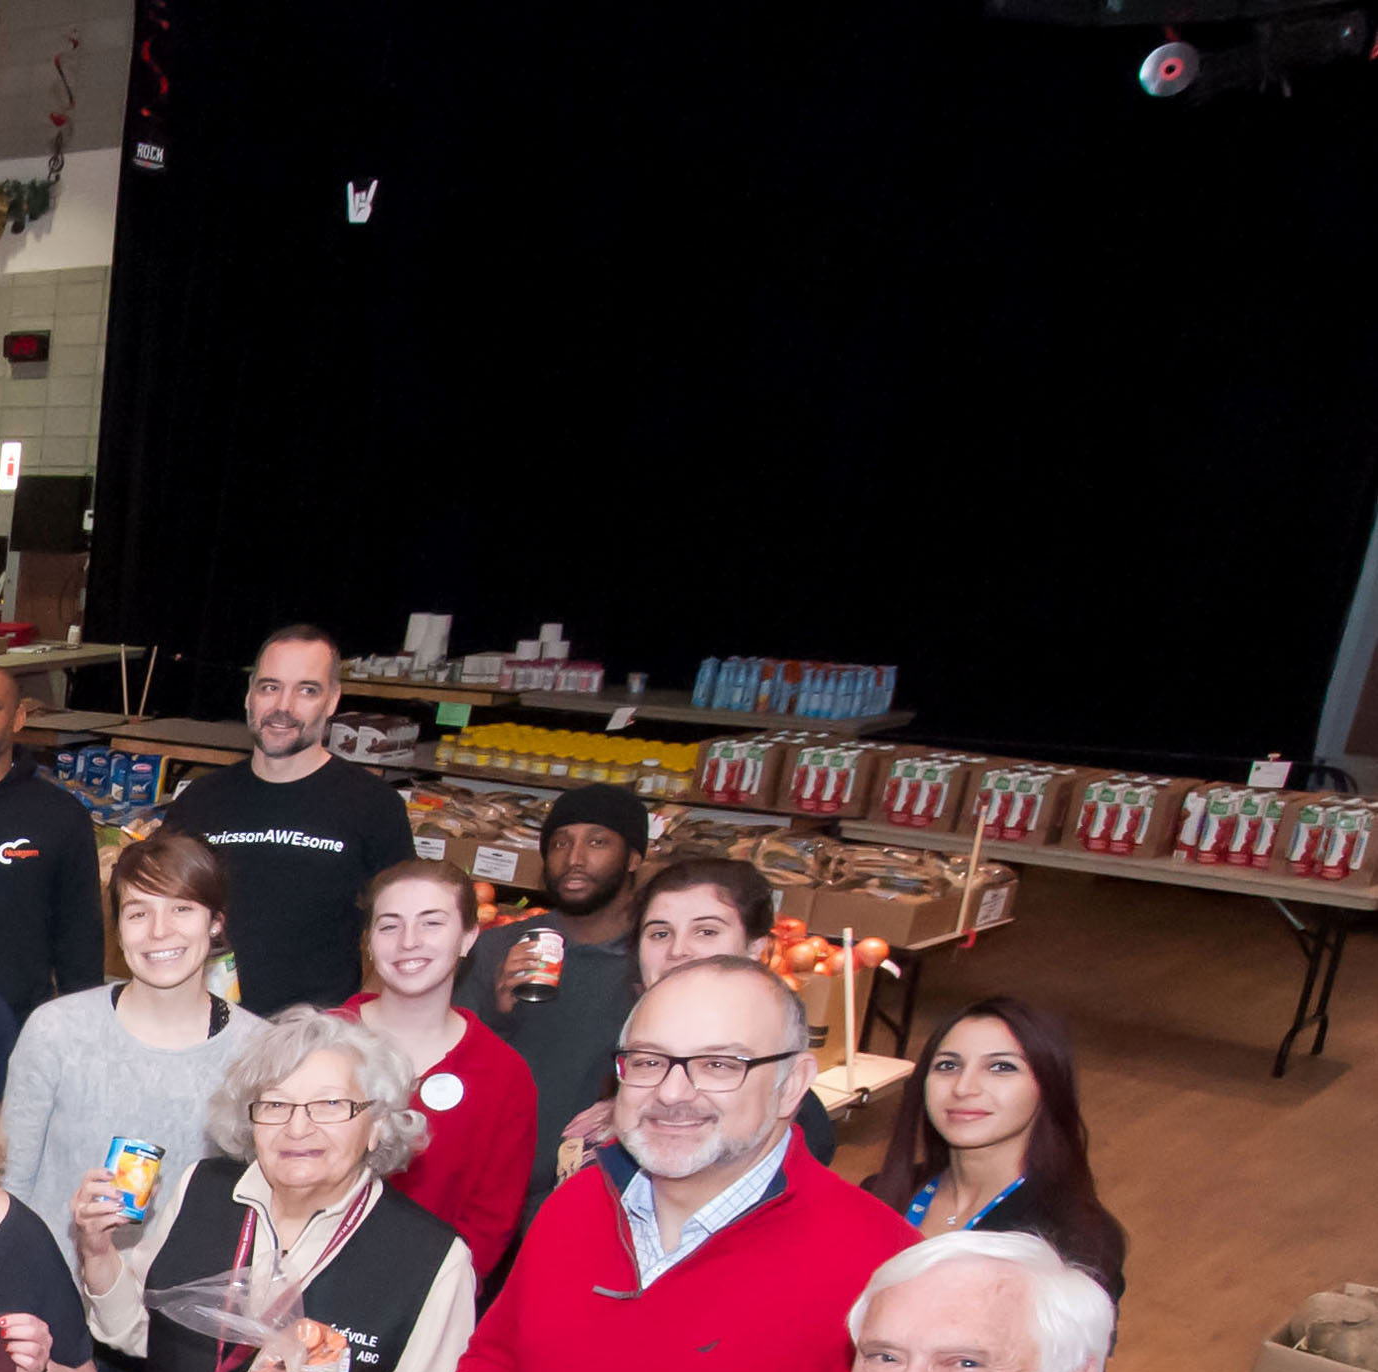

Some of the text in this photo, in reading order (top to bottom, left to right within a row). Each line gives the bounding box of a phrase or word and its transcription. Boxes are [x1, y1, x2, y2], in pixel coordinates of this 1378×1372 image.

[136, 143, 164, 162] ROCK
[203, 828, 344, 853] ericssonAWEsome
[330, 1323, 379, 1348] ÉVOLE
[356, 1350, 380, 1364] ABC
